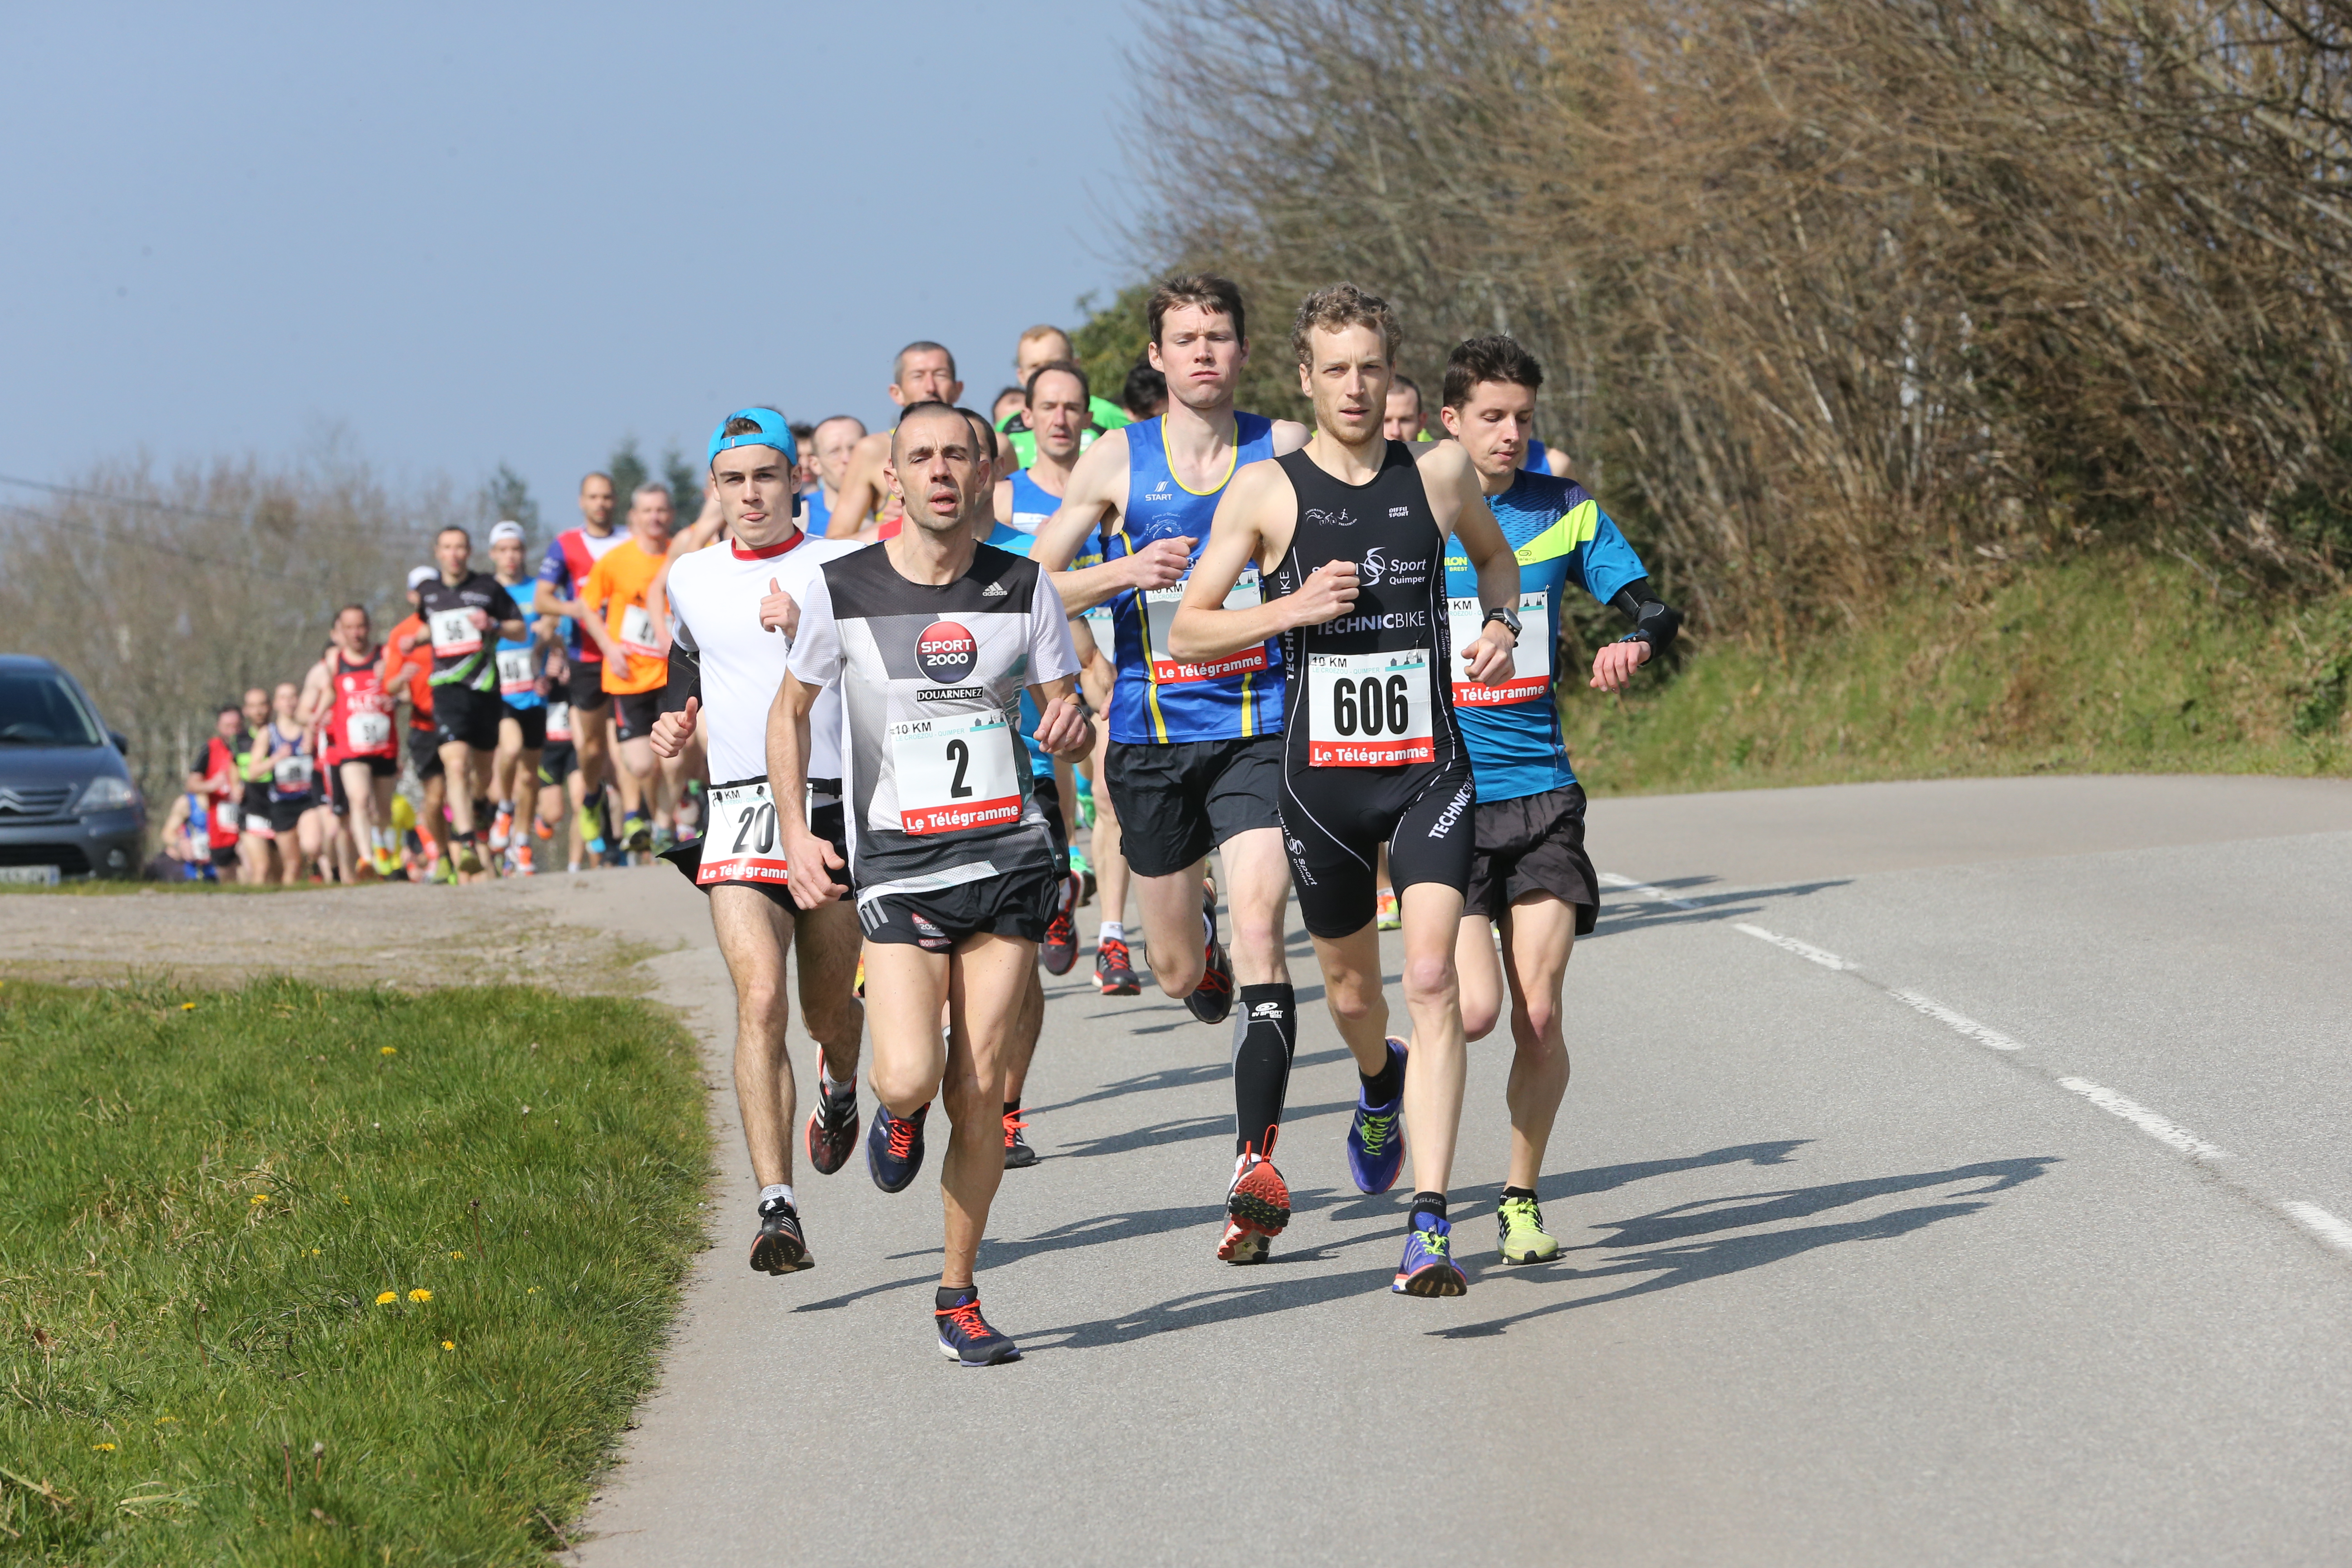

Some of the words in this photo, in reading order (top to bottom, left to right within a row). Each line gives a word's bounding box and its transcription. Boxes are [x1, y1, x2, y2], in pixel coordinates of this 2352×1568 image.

[1338, 518, 1357, 526] TRIATHLON
[1390, 559, 1426, 574] Sport
[1389, 576, 1426, 585] Quimper
[1454, 600, 1471, 610] KM
[921, 639, 972, 653] SPORT
[926, 652, 969, 666] 2000
[1330, 657, 1347, 668] KM
[1159, 667, 1175, 679] Le
[1177, 655, 1262, 677] Télégramme
[917, 688, 982, 700] DOUARNENEZ
[1460, 685, 1545, 703] Télégramme
[1333, 675, 1409, 736] 606
[896, 725, 908, 735] 10
[913, 721, 932, 733] KM
[938, 728, 965, 737] QUIMPER
[1314, 748, 1332, 761] Le
[1335, 746, 1429, 764] Télégramme
[946, 739, 973, 799] 2
[724, 790, 740, 799] KM
[906, 817, 925, 830] Le
[927, 805, 1019, 827] Télégramme
[732, 802, 775, 854] 20
[702, 868, 716, 879] Le
[1293, 858, 1309, 886] Quimper
[1298, 858, 1318, 886] Sport
